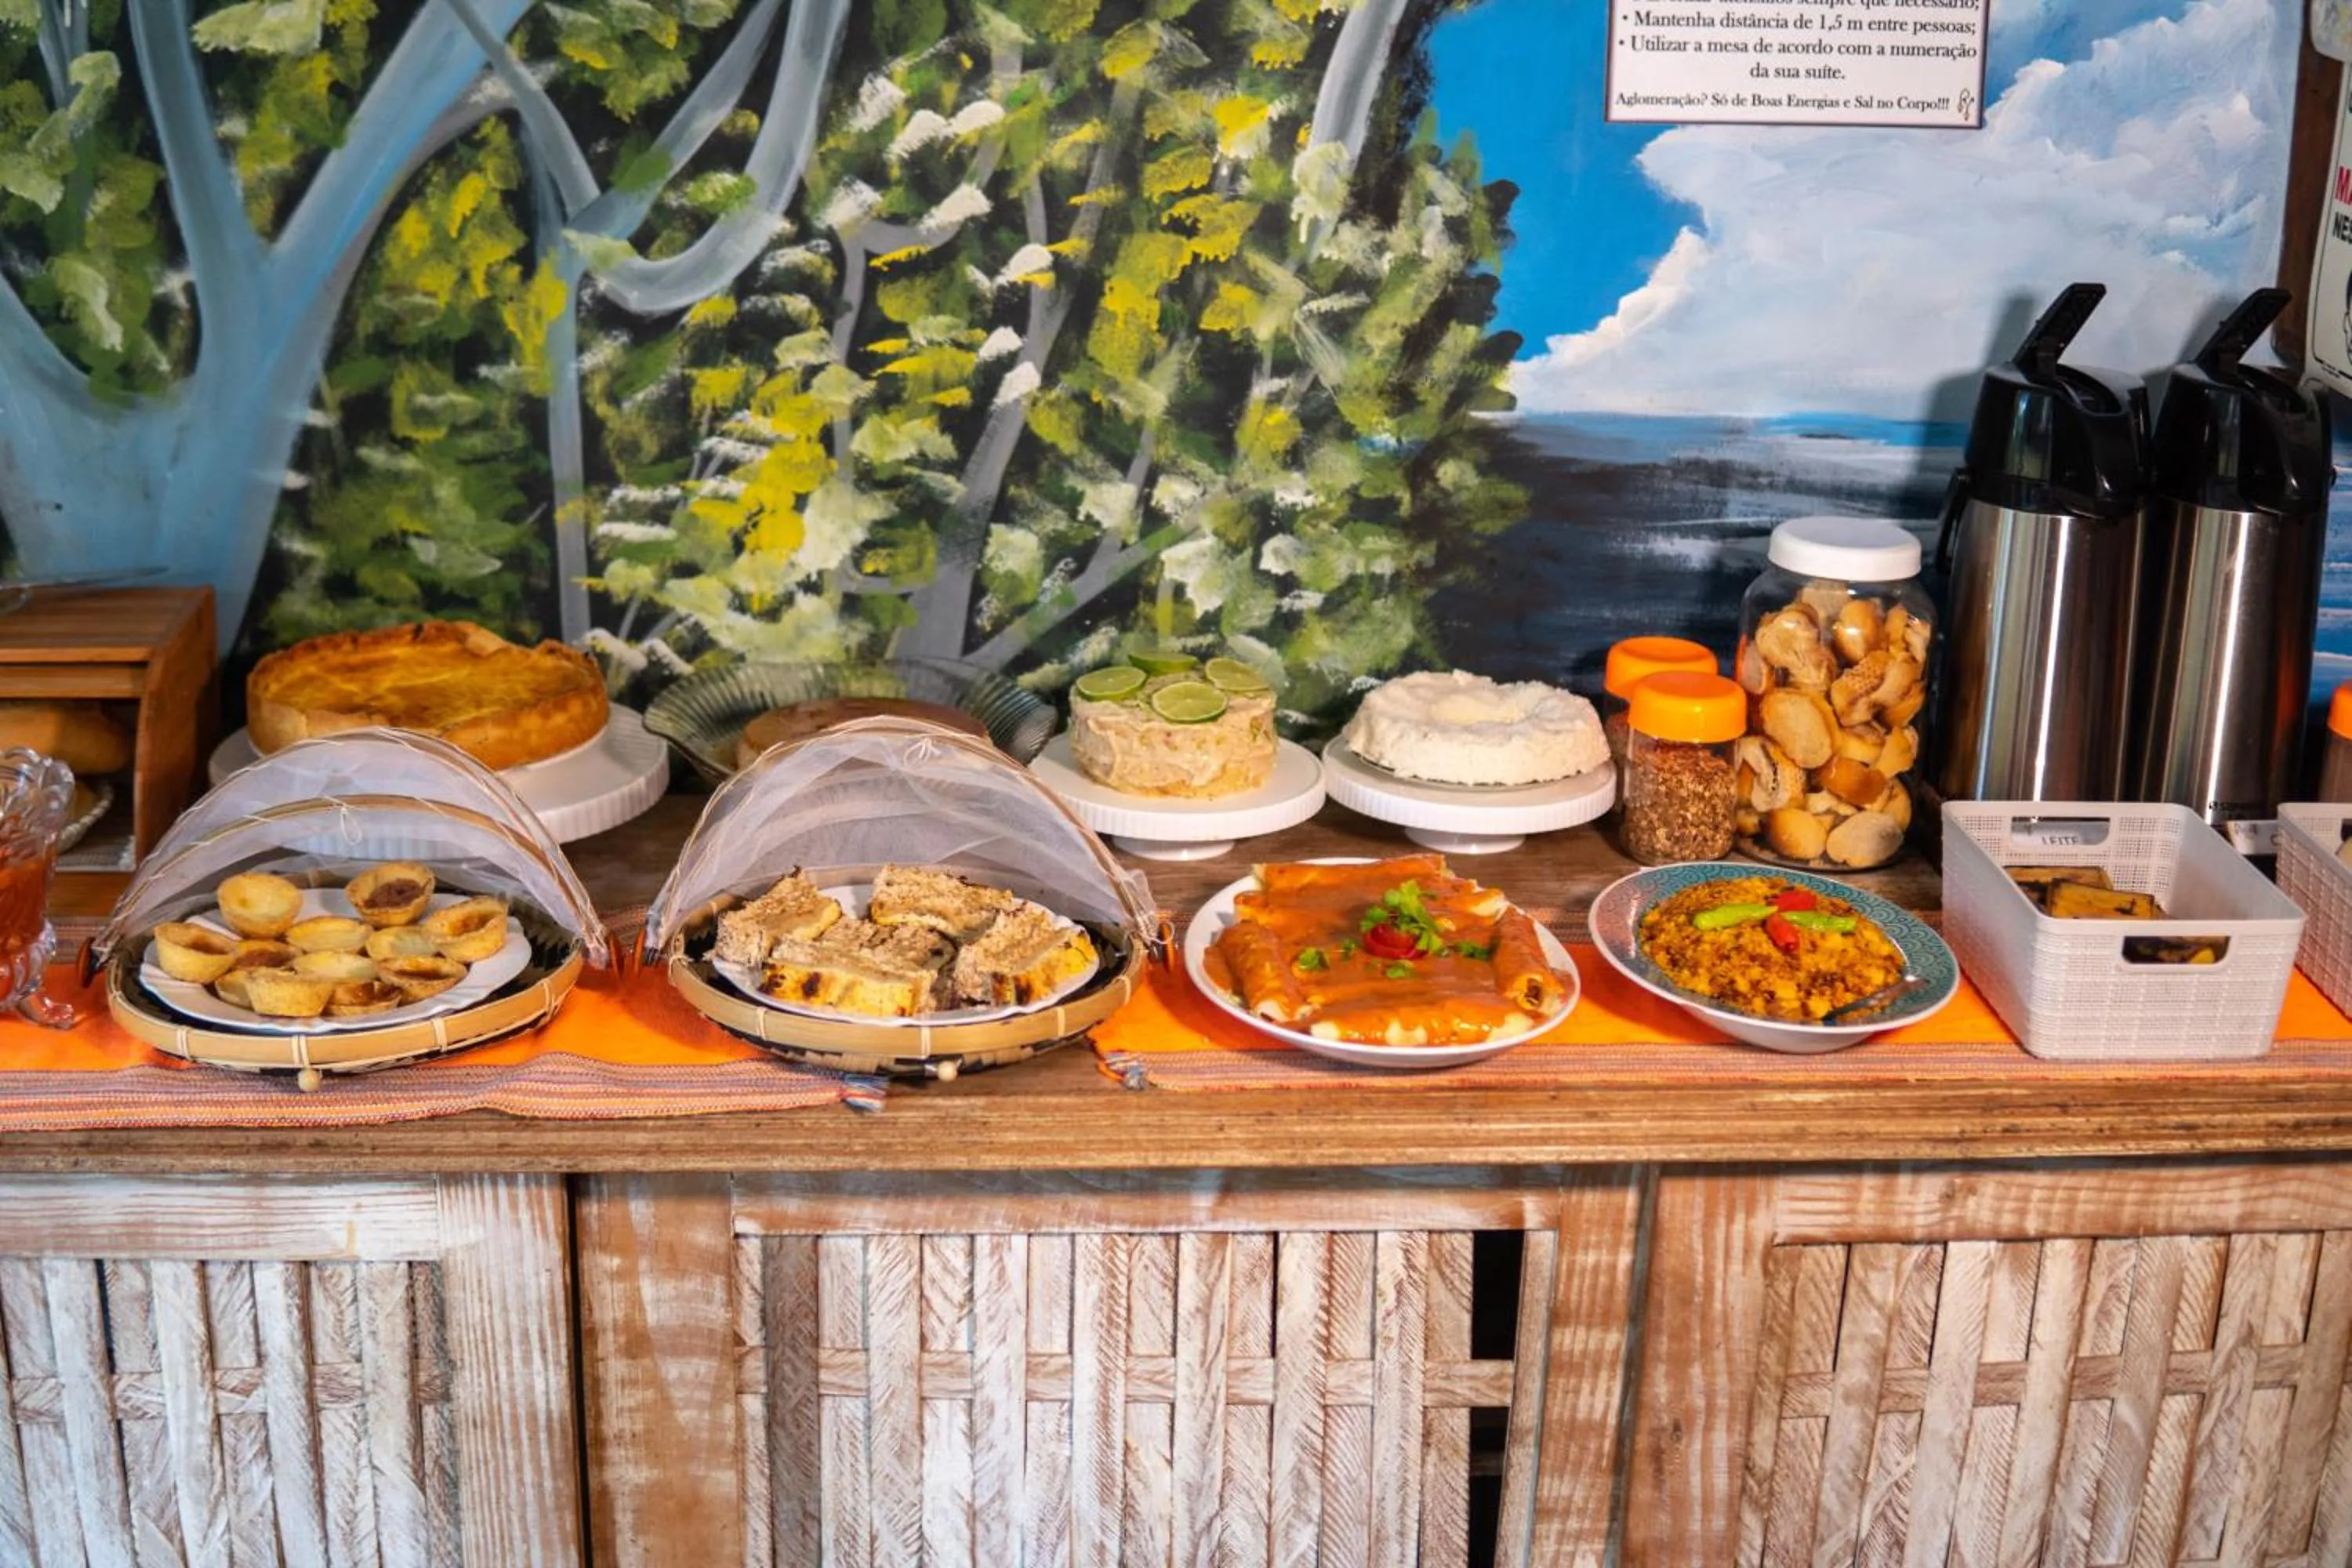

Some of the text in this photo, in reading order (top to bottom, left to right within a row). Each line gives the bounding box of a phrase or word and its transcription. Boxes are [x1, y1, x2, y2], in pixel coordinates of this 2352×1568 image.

[1634, 10, 1976, 34] Mantenha distância de 1,5 m entre pessoas;
[1631, 35, 1977, 60] Utilizar a mesa de acordo com a numeração
[1750, 62, 1846, 79] da sua suíte.
[1616, 93, 1950, 112] Aglomeração? Só de Boas Energias e Sal no Corpo!!!
[2335, 165, 2352, 205] M
